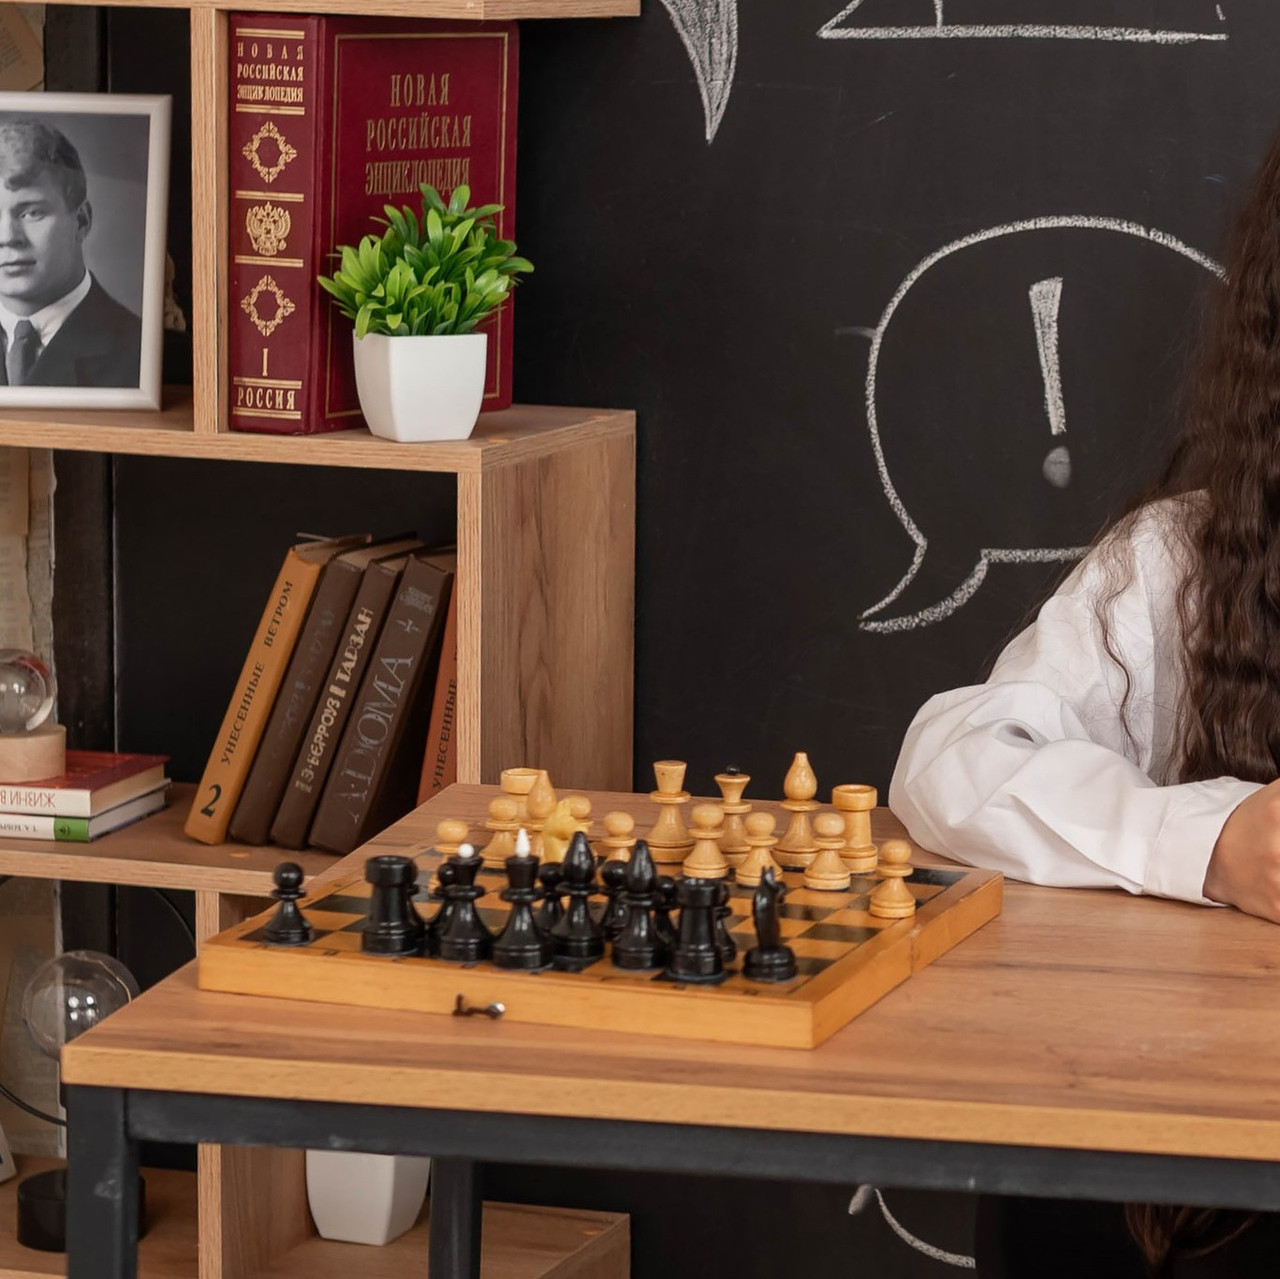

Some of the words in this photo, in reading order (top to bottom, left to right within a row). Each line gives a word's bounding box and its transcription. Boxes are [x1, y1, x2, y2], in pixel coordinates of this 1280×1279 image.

[237, 63, 304, 82] РОССИЙСКАЯ
[237, 84, 304, 103] ЭНЦИКЛОПЕДИЯ
[390, 73, 451, 108] НОВАЯ
[366, 112, 473, 152] РОССИЙСКАЯ
[365, 157, 471, 197] ЭНЦИКЛОПЕДИЯ
[237, 387, 296, 410] РОССИЯ
[336, 607, 374, 683] ТАРЗАН
[221, 661, 265, 765] УНЕСЕННЫЕ
[263, 580, 294, 648] ВЕТРОМ
[10, 789, 56, 809] ЖИЗНИ
[200, 784, 222, 817] 2
